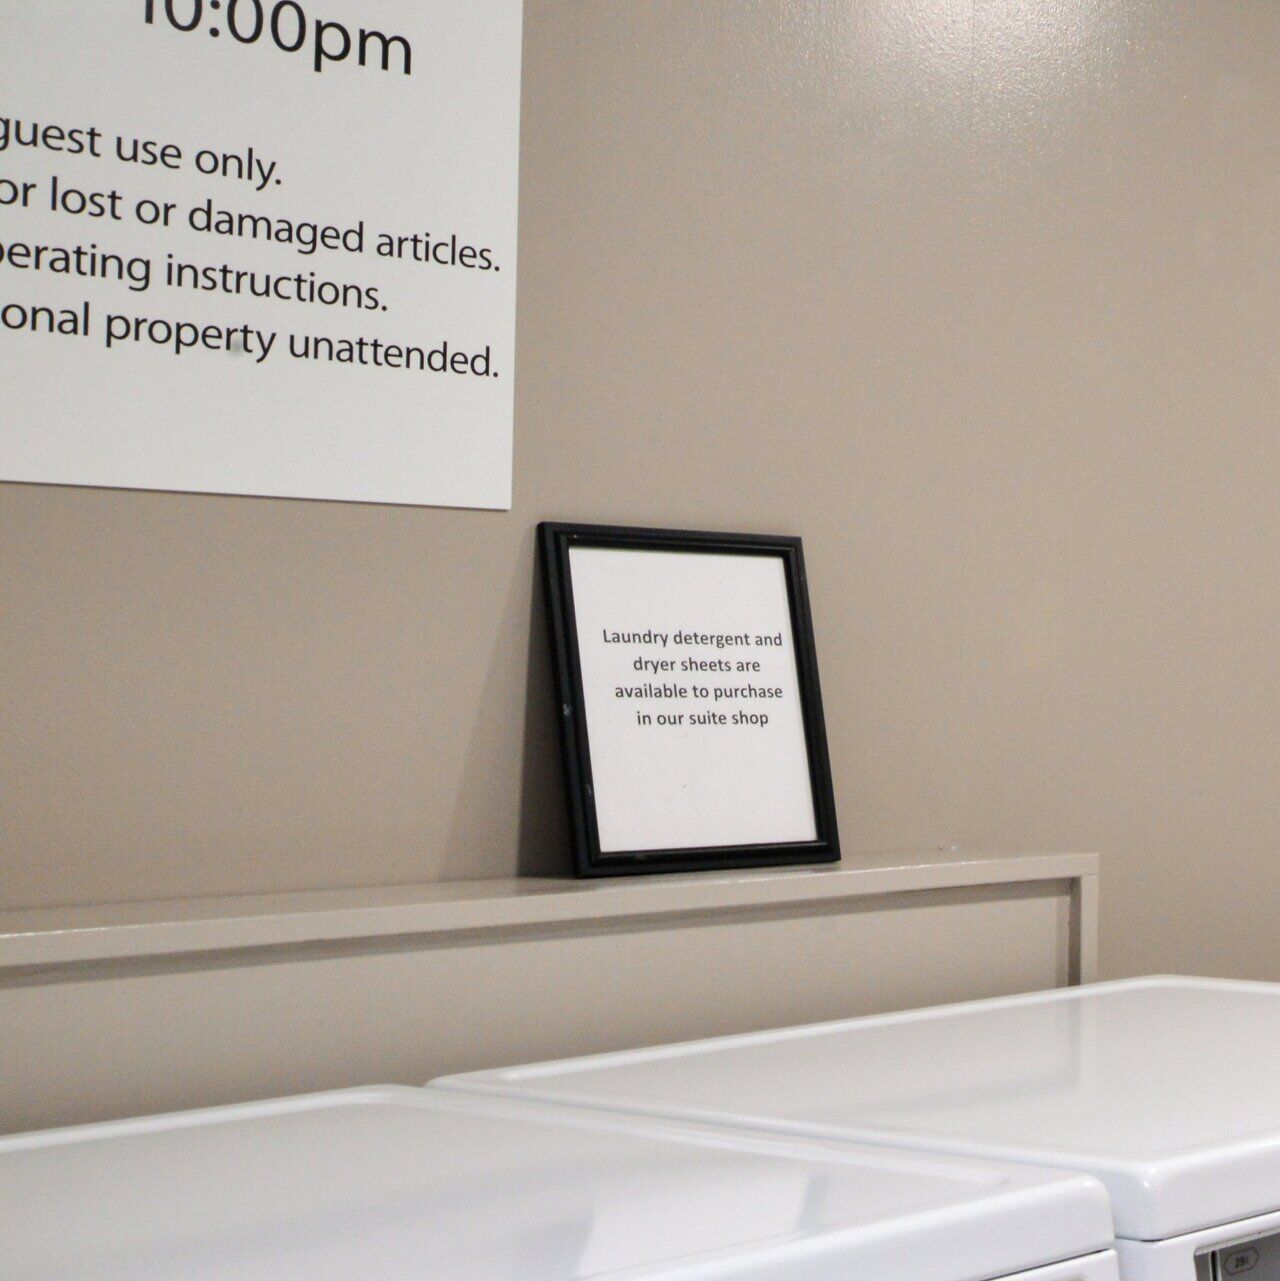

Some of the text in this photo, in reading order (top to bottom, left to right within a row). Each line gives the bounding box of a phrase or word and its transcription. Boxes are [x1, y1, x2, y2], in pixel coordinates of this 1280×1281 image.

[117, 137, 181, 169] use
[195, 147, 281, 191] only.
[51, 176, 122, 220] lost
[136, 200, 176, 226] or
[189, 199, 363, 254] damaged
[377, 233, 499, 271] articles.
[0, 243, 387, 311] erating instructions.
[106, 315, 276, 363] property
[290, 335, 498, 377] unattended.
[602, 629, 783, 649] Laundry detergent and
[633, 657, 761, 675] dryer sheets are
[615, 683, 783, 702] available to purchase
[637, 710, 769, 728] in our suite shop
